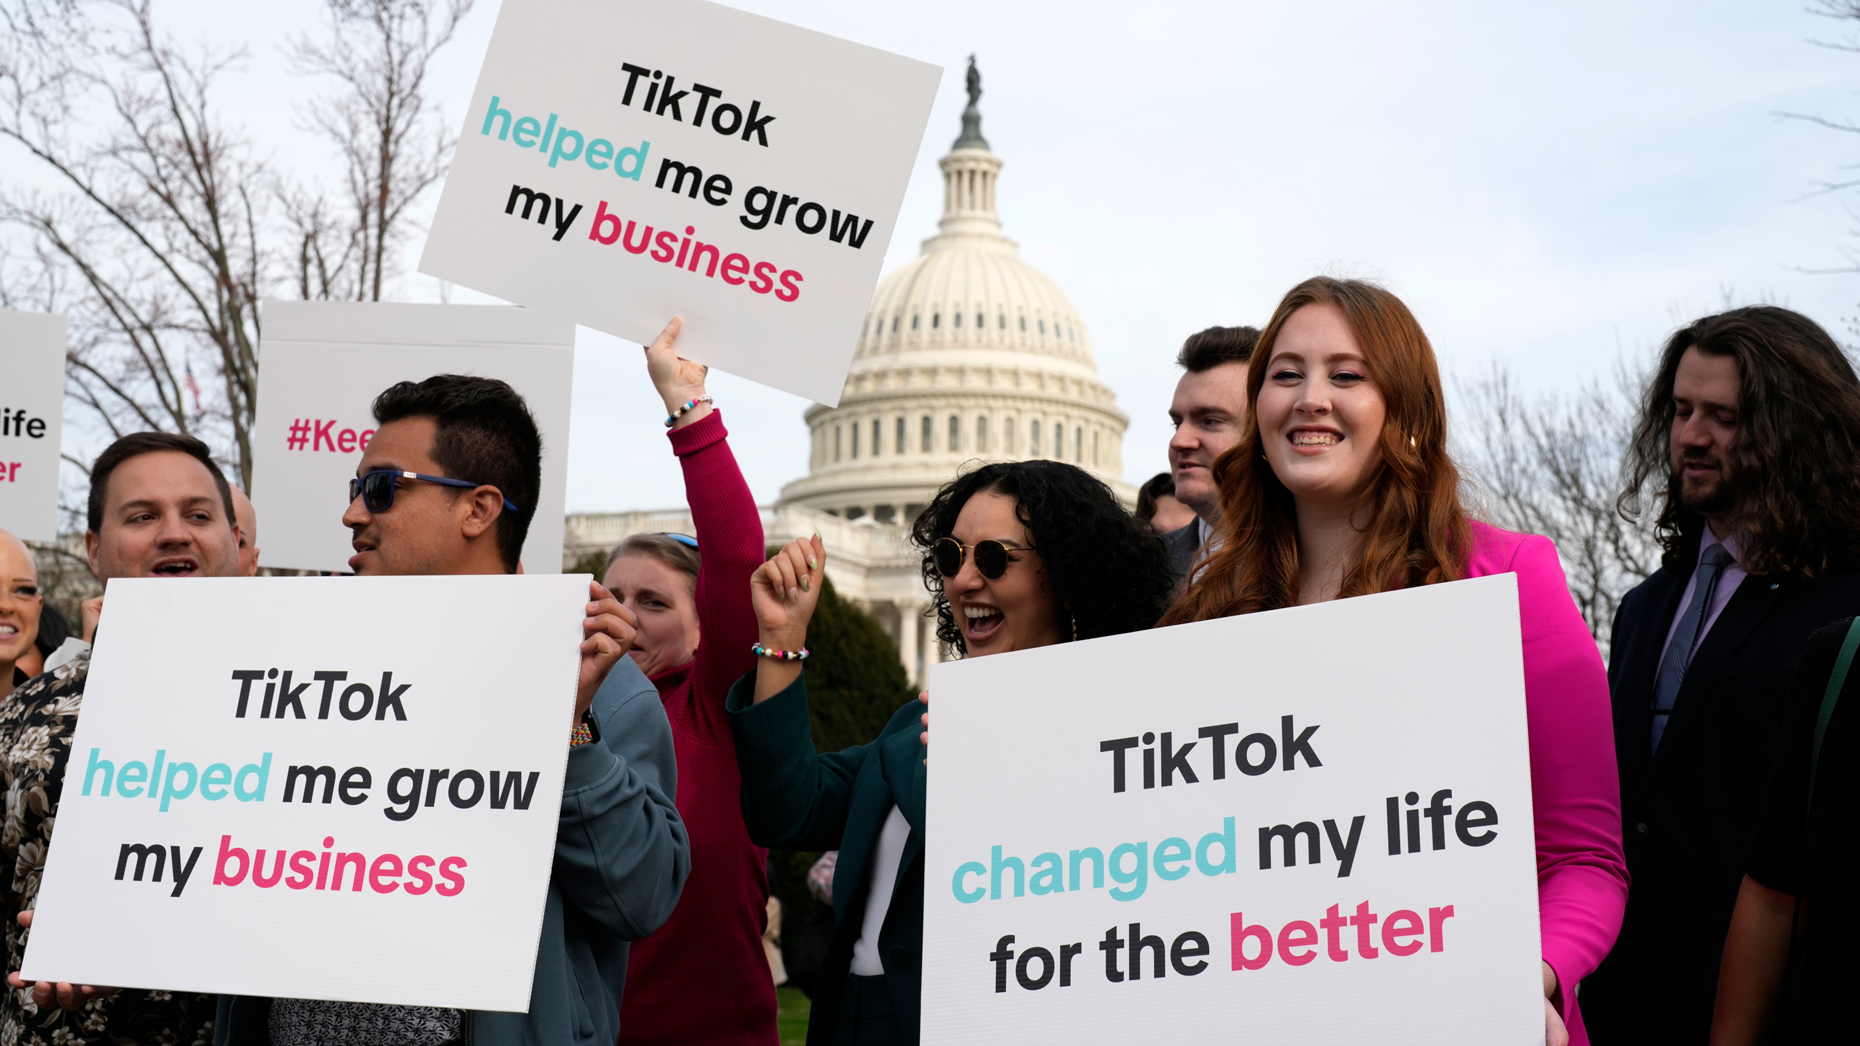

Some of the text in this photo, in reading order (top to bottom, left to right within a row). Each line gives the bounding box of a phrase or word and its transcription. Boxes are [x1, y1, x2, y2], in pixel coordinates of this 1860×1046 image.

[620, 62, 777, 147] TikTok
[481, 96, 875, 250] helped me grow
[504, 184, 804, 303] my business
[0, 407, 47, 439] ife
[232, 668, 411, 721] TikTok
[81, 748, 540, 822] helped me grow
[1100, 715, 1323, 794] TikTok
[114, 835, 468, 898] my business
[951, 789, 1499, 904] changed my life
[989, 900, 1455, 994] for the better
